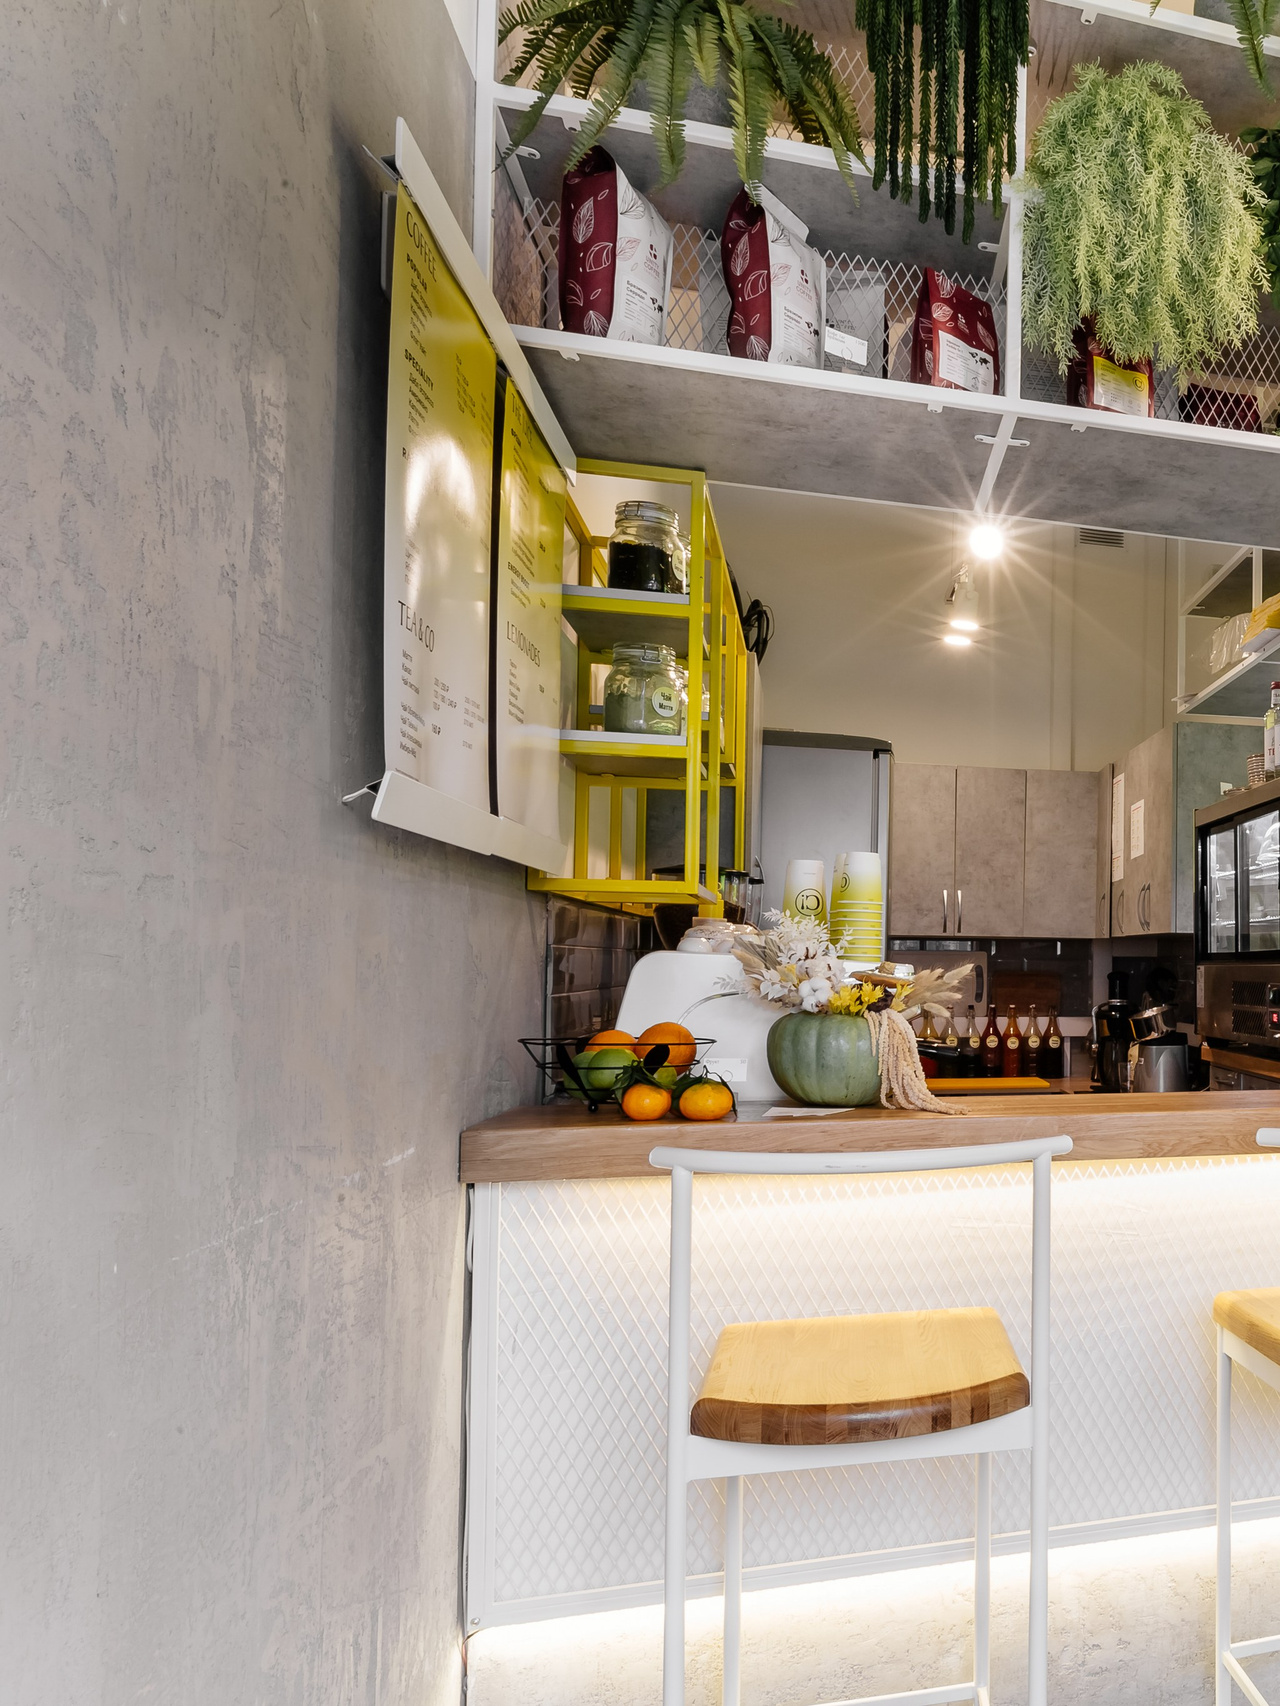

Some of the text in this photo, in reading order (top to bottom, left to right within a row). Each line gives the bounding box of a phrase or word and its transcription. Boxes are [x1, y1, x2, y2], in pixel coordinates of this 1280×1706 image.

[407, 211, 437, 282] COFFEE
[407, 253, 427, 293] POPULAR
[398, 600, 434, 652] TEA & CO
[506, 621, 540, 667] LEMONADES
[661, 692, 671, 701] Чай
